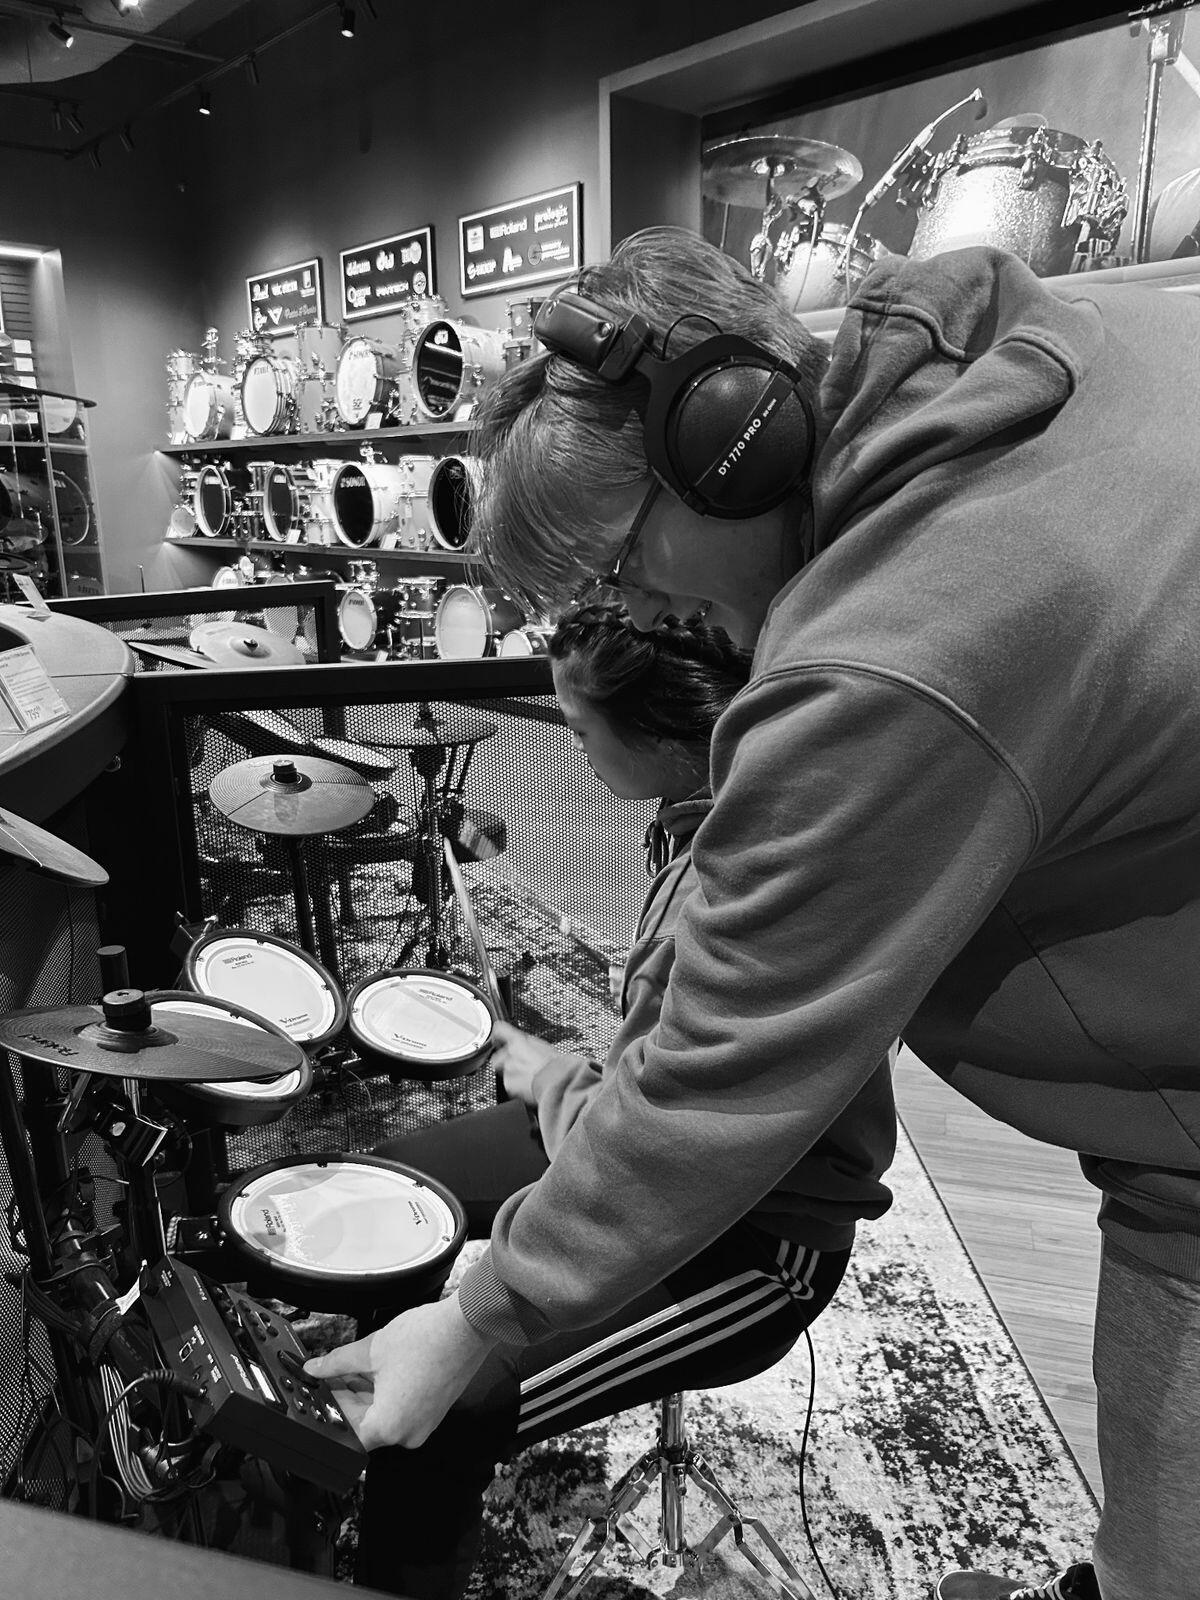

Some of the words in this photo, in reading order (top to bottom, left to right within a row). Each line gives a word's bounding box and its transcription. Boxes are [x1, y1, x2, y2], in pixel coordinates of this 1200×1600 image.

[718, 460, 731, 476] DT
[728, 440, 746, 462] 770
[743, 418, 762, 441] PRO
